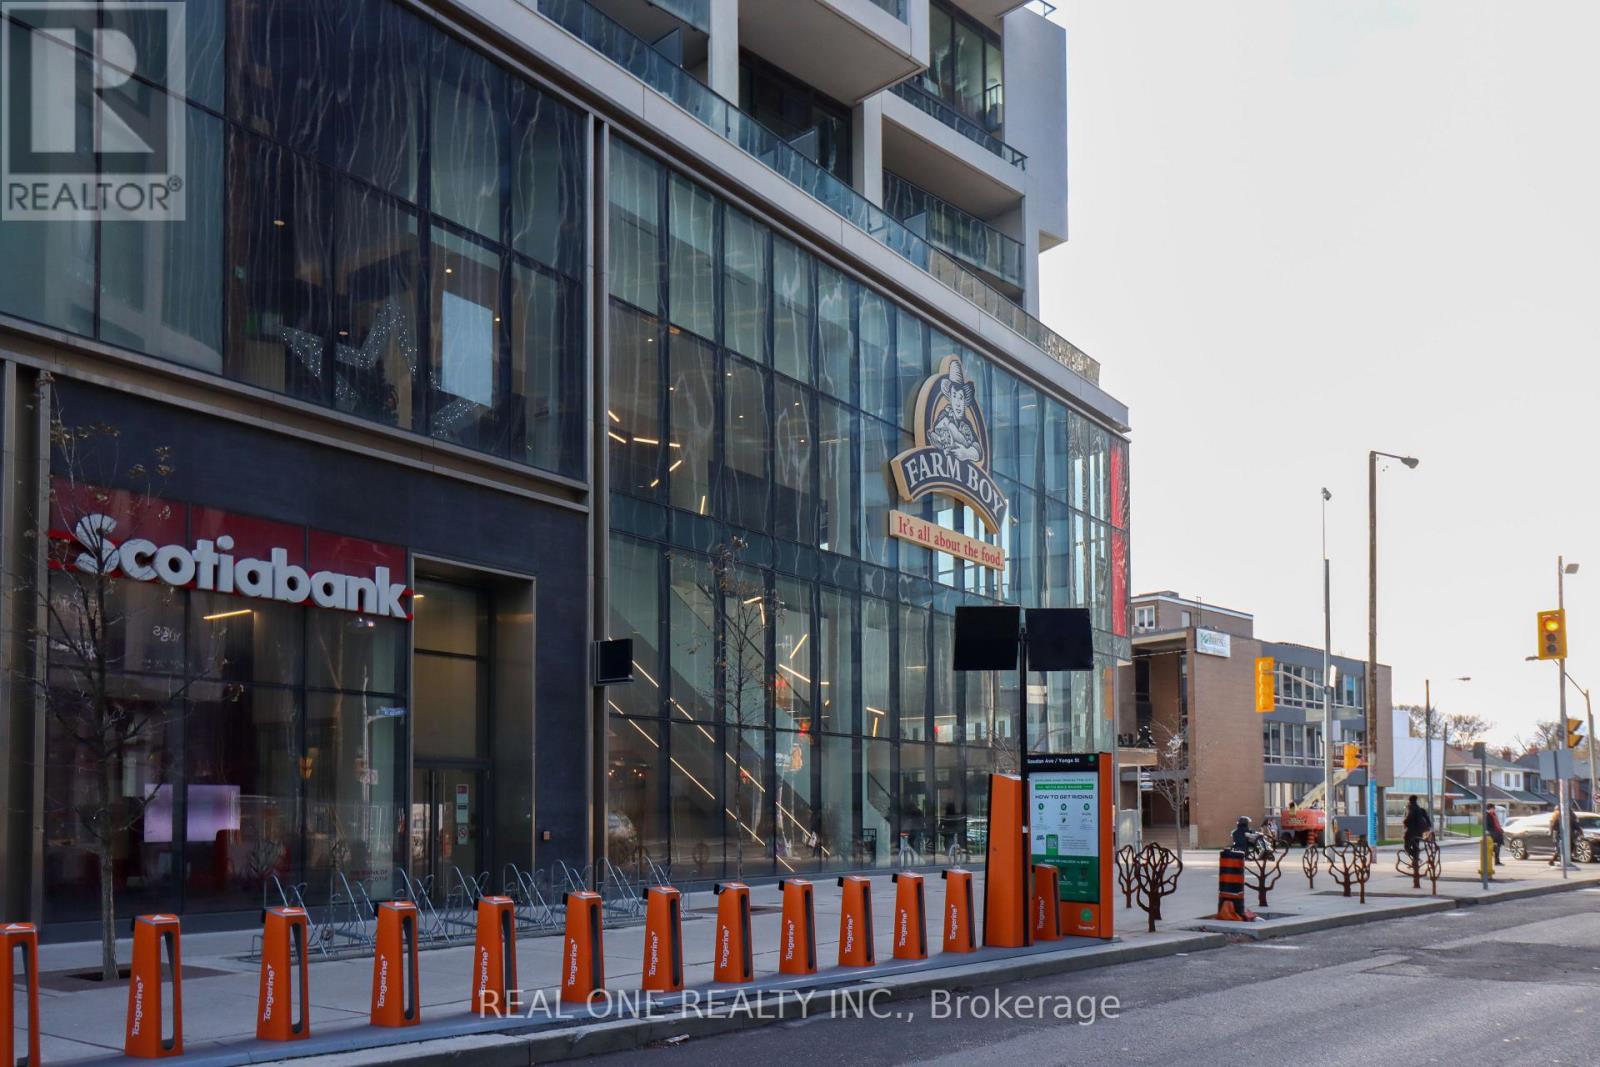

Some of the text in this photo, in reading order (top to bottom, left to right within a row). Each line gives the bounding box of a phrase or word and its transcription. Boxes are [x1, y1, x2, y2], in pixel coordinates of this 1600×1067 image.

[905, 452, 1004, 518] FARM BOY
[898, 516, 1003, 567] It's all about the food.
[74, 513, 409, 620] Scotiabank
[786, 923, 794, 961] Tangerine
[846, 917, 854, 955] Tangerine
[899, 913, 907, 948] Tangerine
[950, 907, 958, 941] Tangerine
[568, 943, 578, 988] Tangerine
[648, 936, 658, 977] Tangerine
[720, 929, 729, 969] Tangerine
[263, 969, 276, 1022] Tangerine
[377, 959, 388, 1008] Tangerine
[131, 980, 144, 1037] Tangerine
